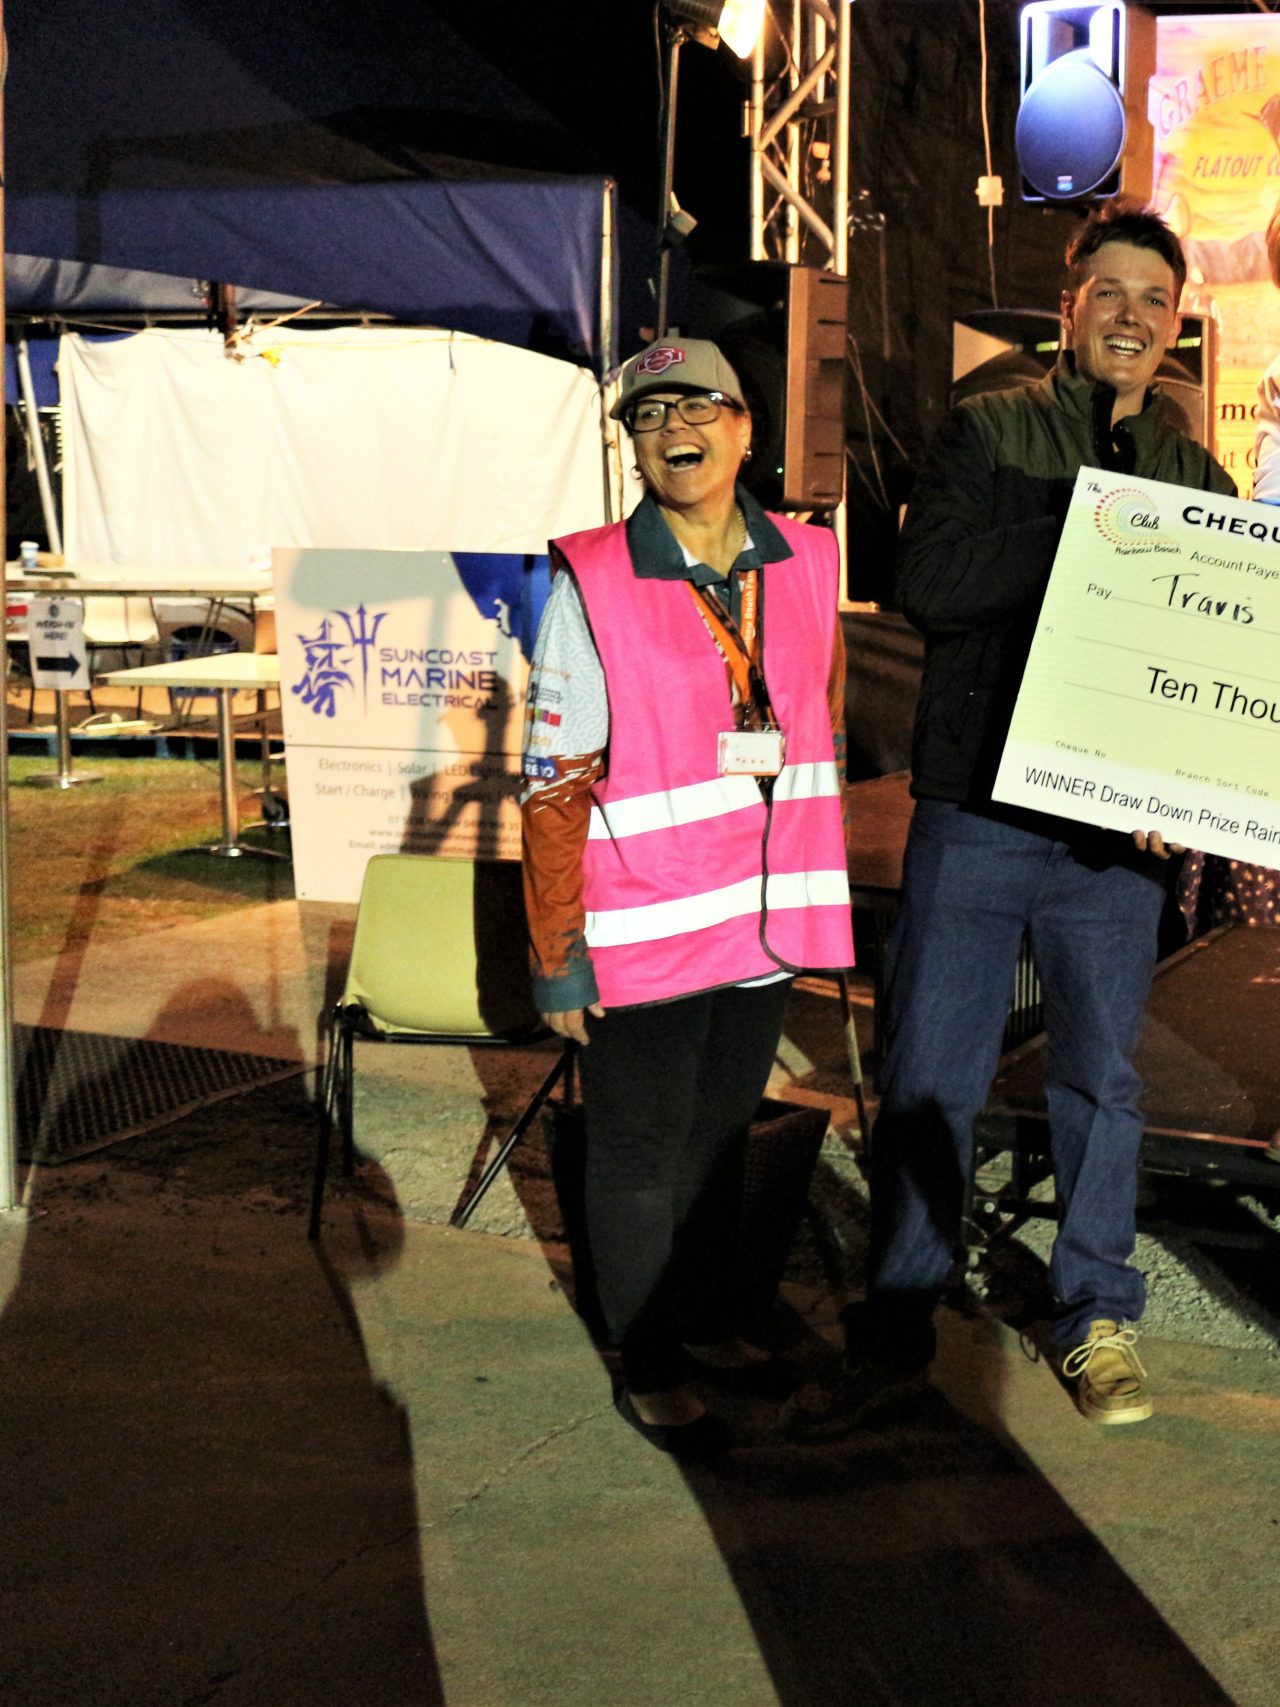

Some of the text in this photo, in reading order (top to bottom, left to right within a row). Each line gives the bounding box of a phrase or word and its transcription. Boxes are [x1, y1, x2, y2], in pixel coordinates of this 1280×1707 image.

[1159, 46, 1268, 135] GRAEME
[1193, 155, 1263, 178] FLATOUT
[1087, 482, 1103, 494] The
[1130, 513, 1160, 530] Club
[1190, 551, 1243, 572] Account
[1087, 583, 1112, 600] Pay
[1152, 573, 1255, 624] Travis
[380, 648, 498, 664] SUNCOAST
[382, 668, 498, 692] MARINE
[1146, 666, 1199, 705] Ten
[382, 693, 498, 709] ELECTRICAL
[1055, 739, 1089, 755] Cheque
[319, 758, 382, 773] Electronics
[399, 761, 427, 774] Solar
[445, 765, 468, 778] LED
[315, 784, 343, 796] Start
[353, 784, 395, 800] Charge
[1174, 768, 1211, 784] Branch
[1246, 784, 1270, 798] Code
[1024, 766, 1097, 800] WINNER
[1099, 785, 1144, 810] Draw
[1146, 796, 1193, 824] Down
[1197, 809, 1240, 835] Prize
